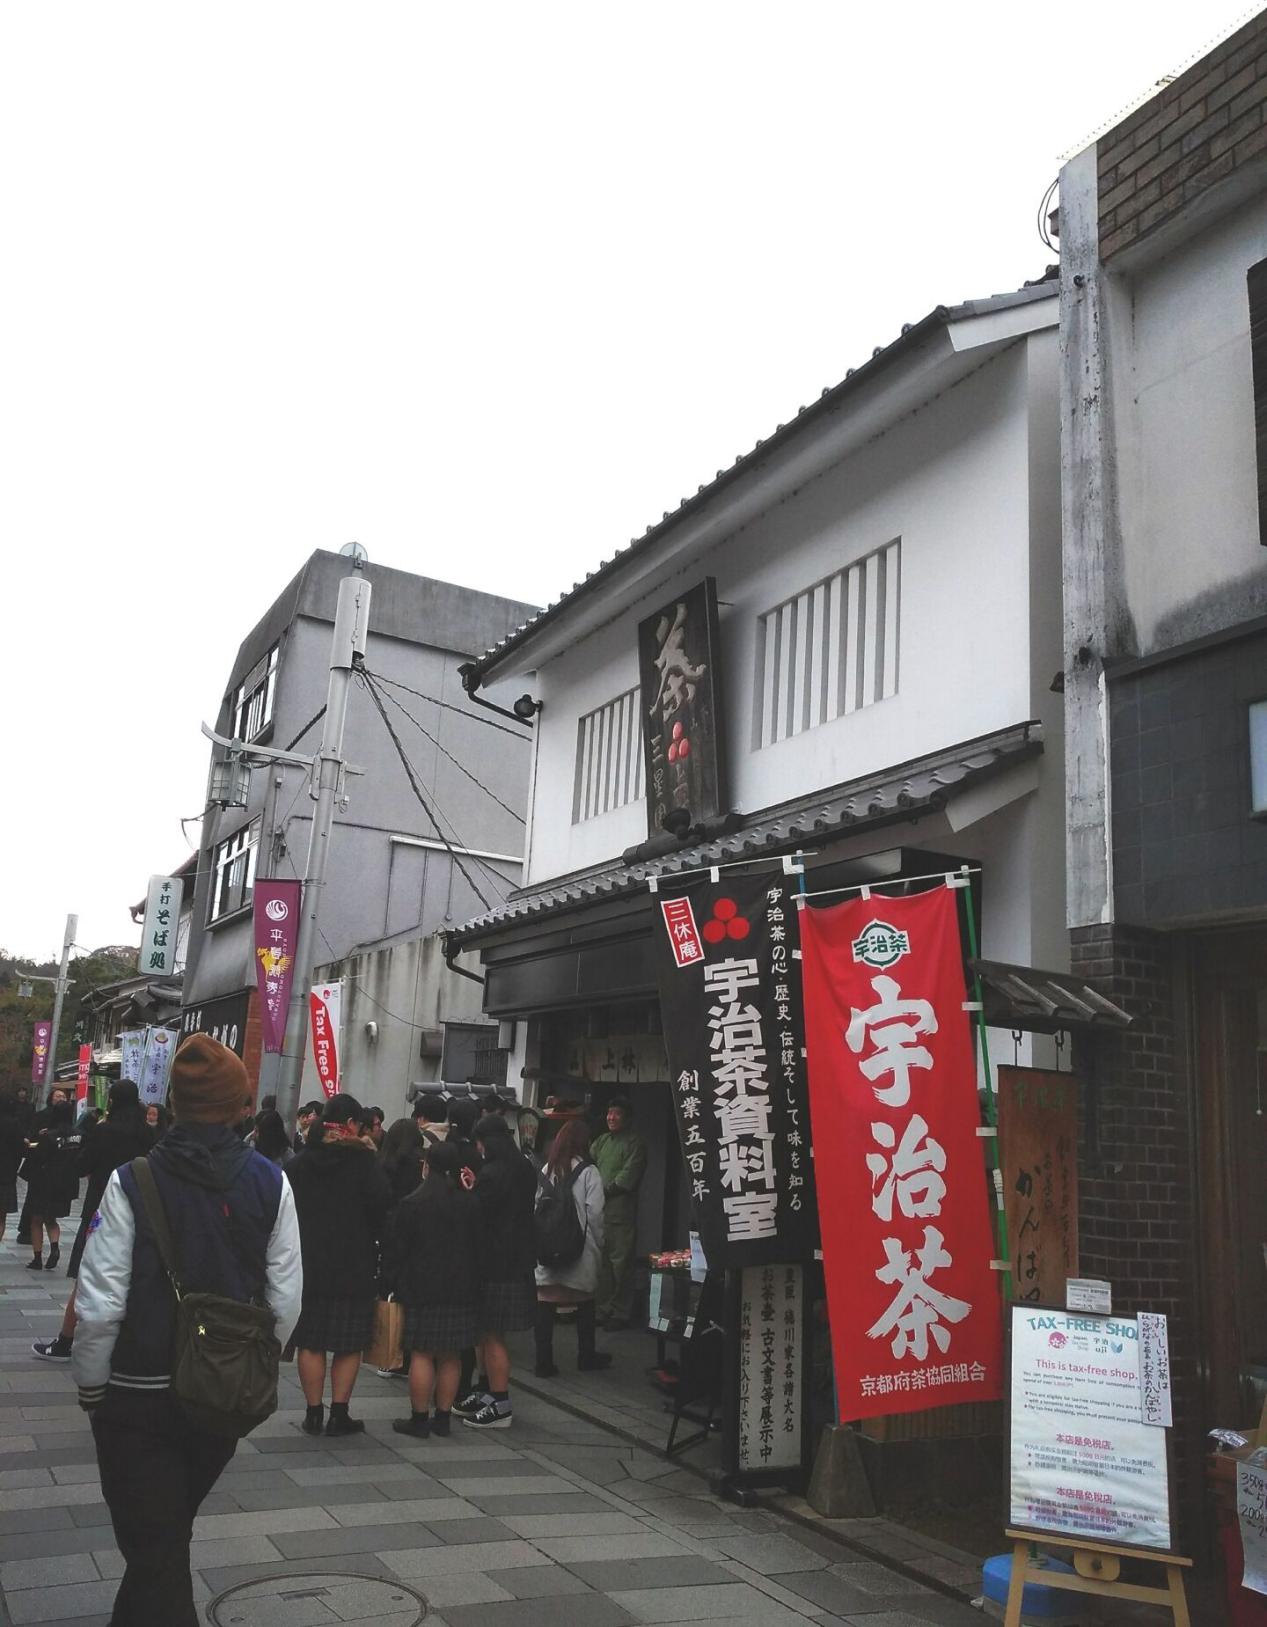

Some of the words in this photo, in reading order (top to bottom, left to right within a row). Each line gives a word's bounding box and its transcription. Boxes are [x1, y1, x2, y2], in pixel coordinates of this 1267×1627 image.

[149, 881, 173, 969] 手打そば処
[668, 903, 699, 961] 三休庵
[853, 934, 908, 958] 宇治茶
[315, 1005, 326, 1037] Tax
[317, 1040, 329, 1076] Free
[703, 958, 779, 1242] 宇治茶資料室
[676, 1069, 710, 1203] 創業五百年
[845, 975, 972, 1361] 宇治茶
[1026, 1316, 1101, 1333] TAX-FREE
[859, 1360, 987, 1397] 京都府茶協同組合
[1035, 1359, 1056, 1371] This
[1058, 1361, 1066, 1371] is
[1069, 1363, 1108, 1376] tax-free
[1110, 1367, 1138, 1381] shop.
